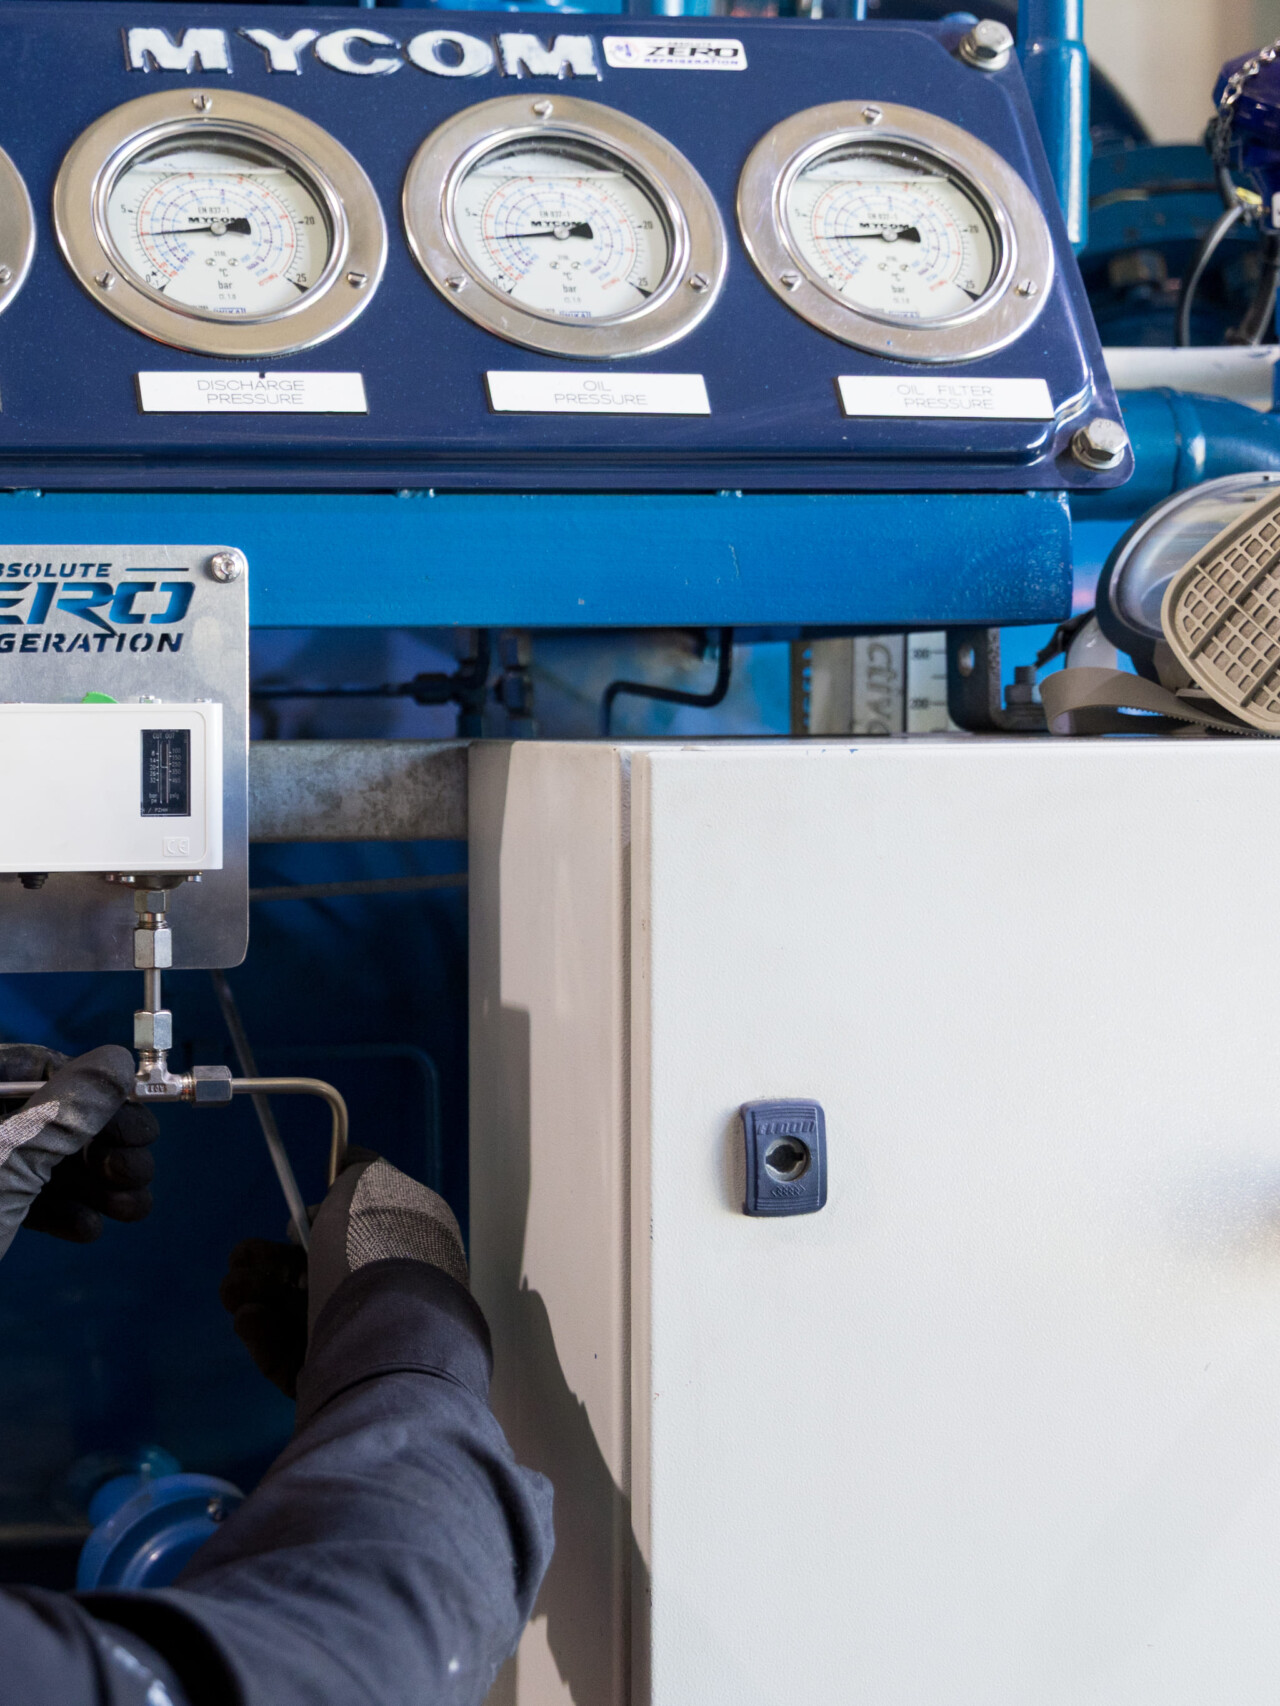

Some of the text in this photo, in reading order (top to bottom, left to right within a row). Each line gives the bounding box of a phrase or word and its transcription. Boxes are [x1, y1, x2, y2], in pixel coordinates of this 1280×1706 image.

[122, 27, 603, 81] MYCOM
[648, 46, 739, 58] ZERO
[305, 216, 315, 225] 20
[643, 221, 653, 229] 20
[859, 222, 910, 230] MYCOM
[296, 274, 306, 282] 25
[218, 281, 232, 290] bar
[563, 284, 577, 293] bar
[197, 379, 305, 391] DISCHARGE
[583, 380, 611, 392] OIL
[897, 384, 993, 397] OIL FILTER
[207, 393, 304, 405] PRESSURE
[554, 393, 648, 405] PRESSURE
[904, 398, 994, 410] PRESSURE
